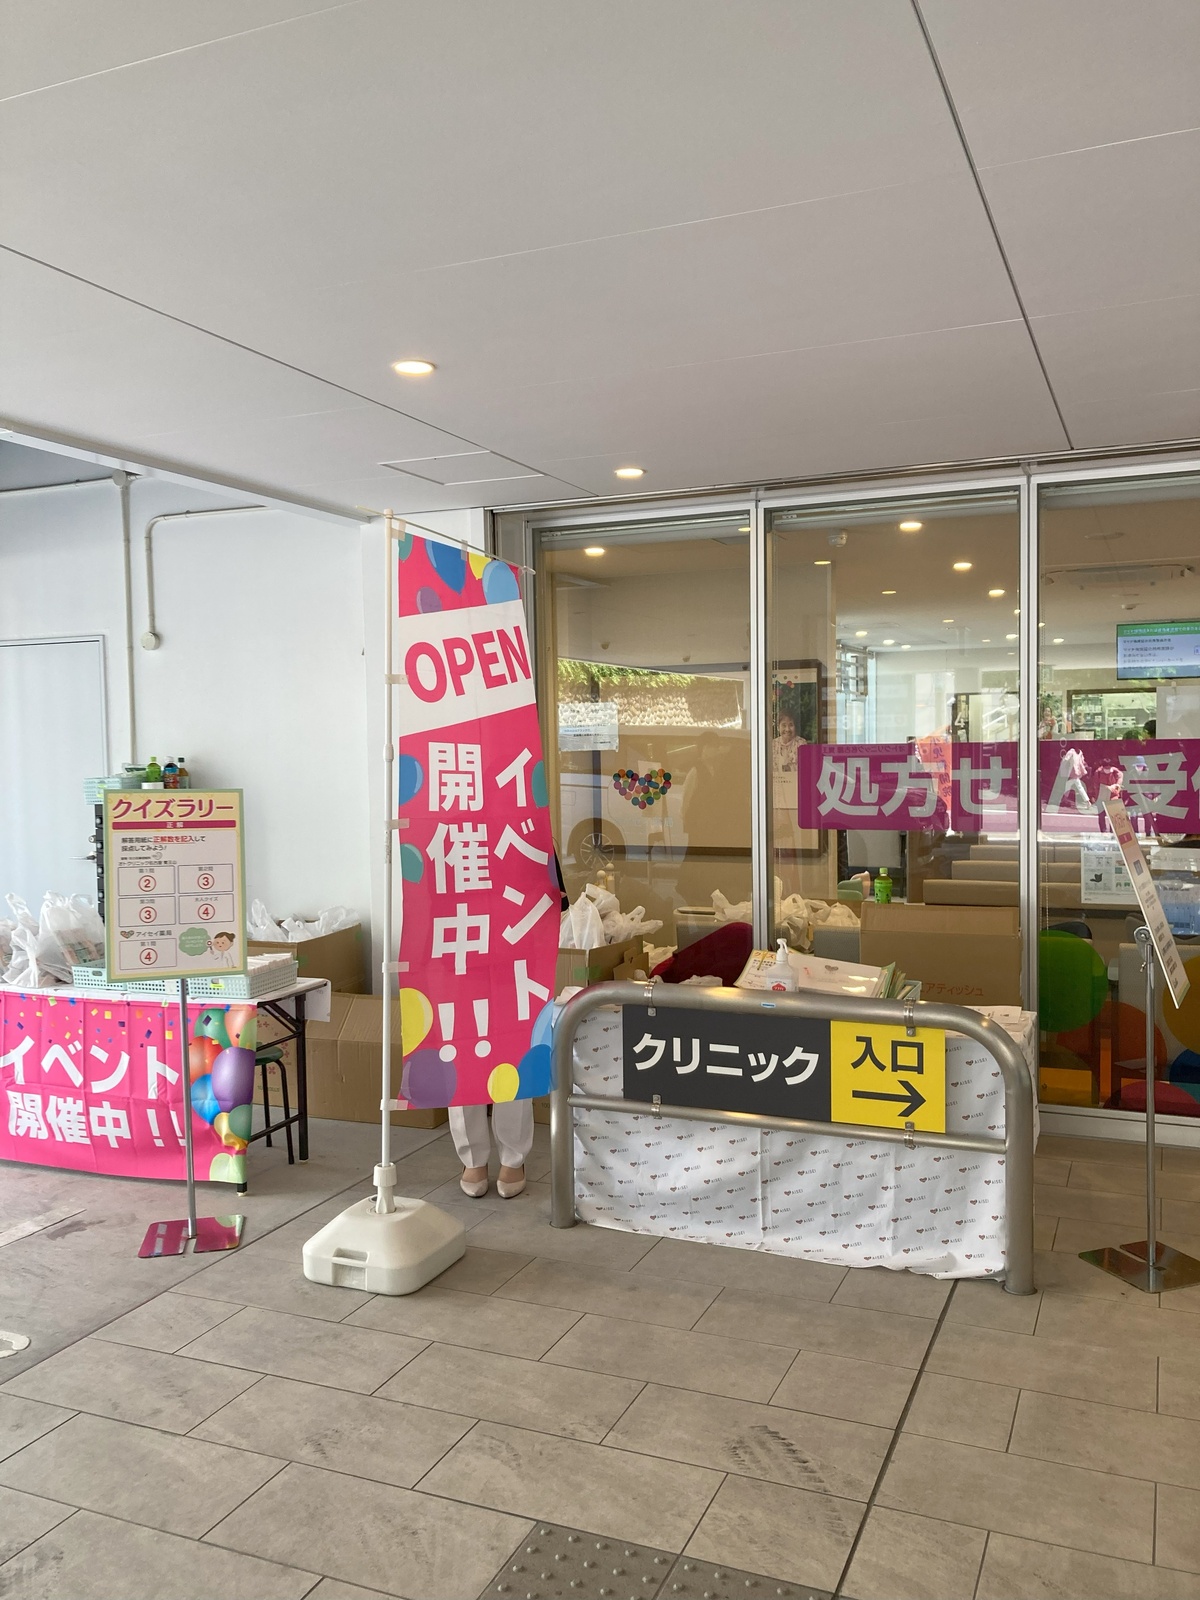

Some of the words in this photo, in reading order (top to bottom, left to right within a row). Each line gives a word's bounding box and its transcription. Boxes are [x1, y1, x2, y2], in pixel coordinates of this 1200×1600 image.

[404, 625, 532, 704] OPEN
[112, 799, 234, 819] クイズラリー
[494, 747, 554, 1021] イベント
[0, 1036, 179, 1100] イベント
[632, 1033, 820, 1086] クリニック
[850, 1035, 925, 1075] 入口
